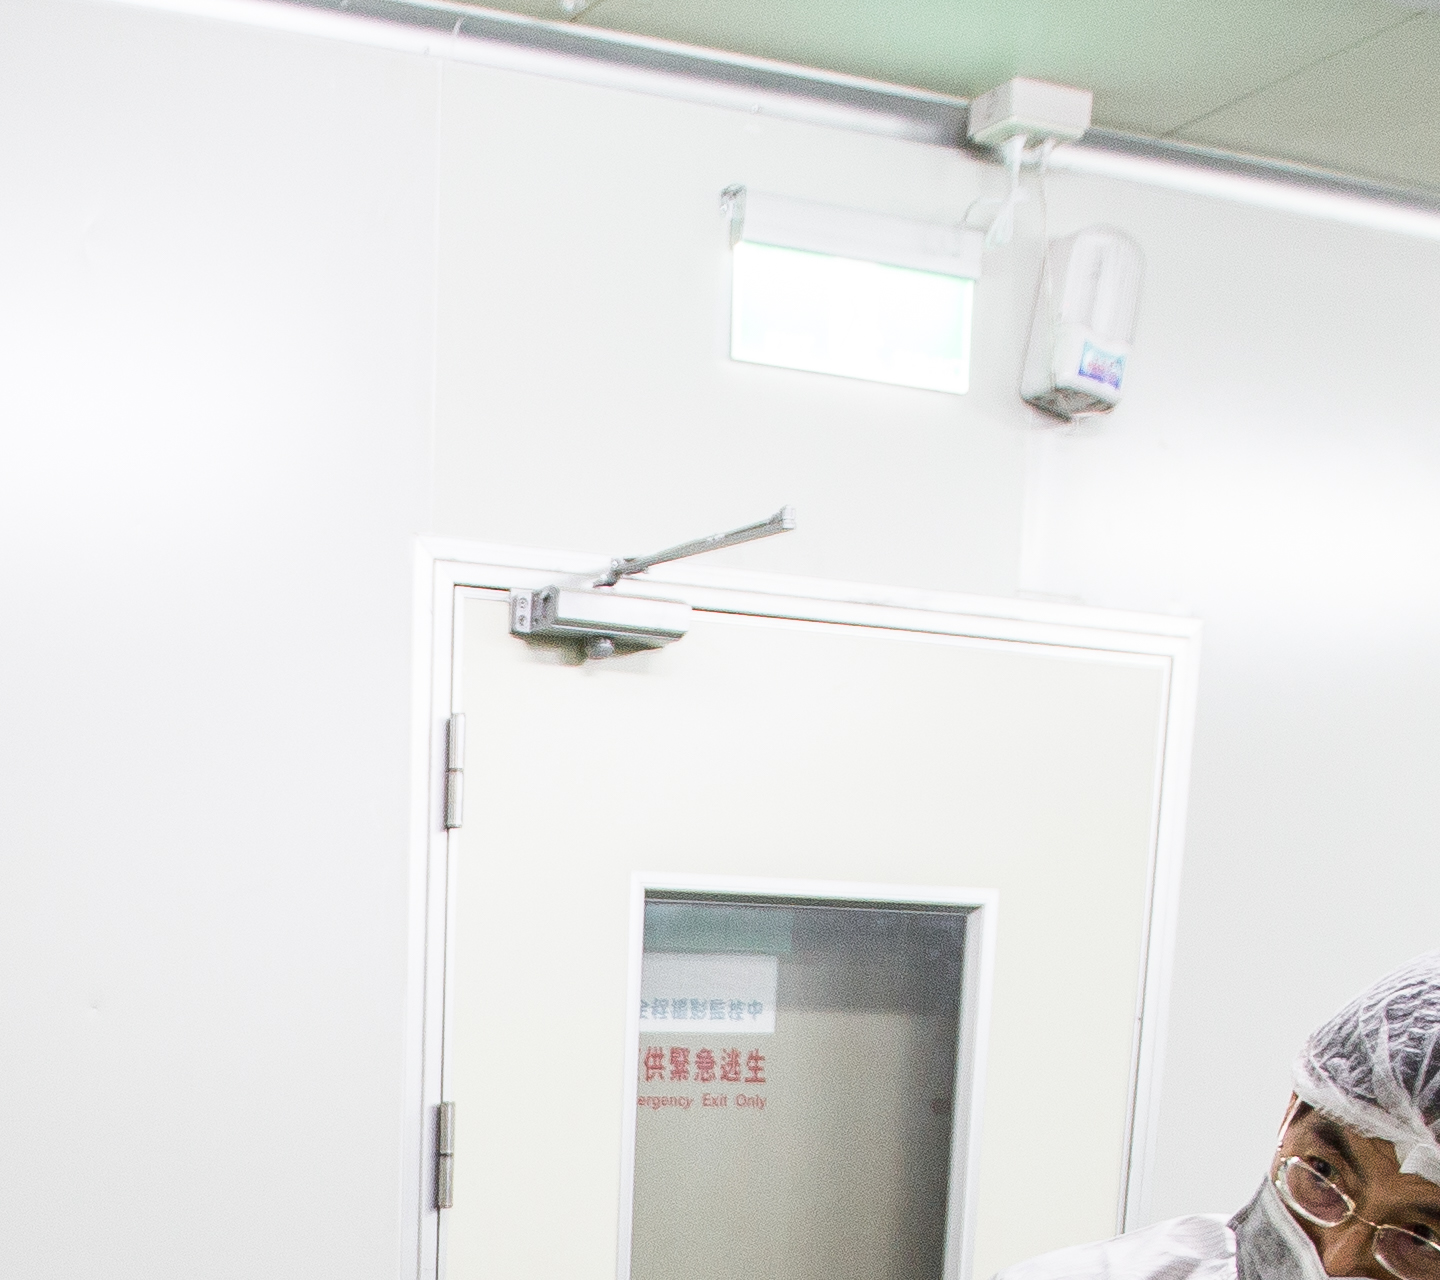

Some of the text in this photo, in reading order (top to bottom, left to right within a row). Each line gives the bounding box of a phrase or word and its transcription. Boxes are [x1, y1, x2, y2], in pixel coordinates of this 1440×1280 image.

[638, 1046, 766, 1083] 供緊急逃生
[637, 1093, 767, 1111] ergency Exit Only
